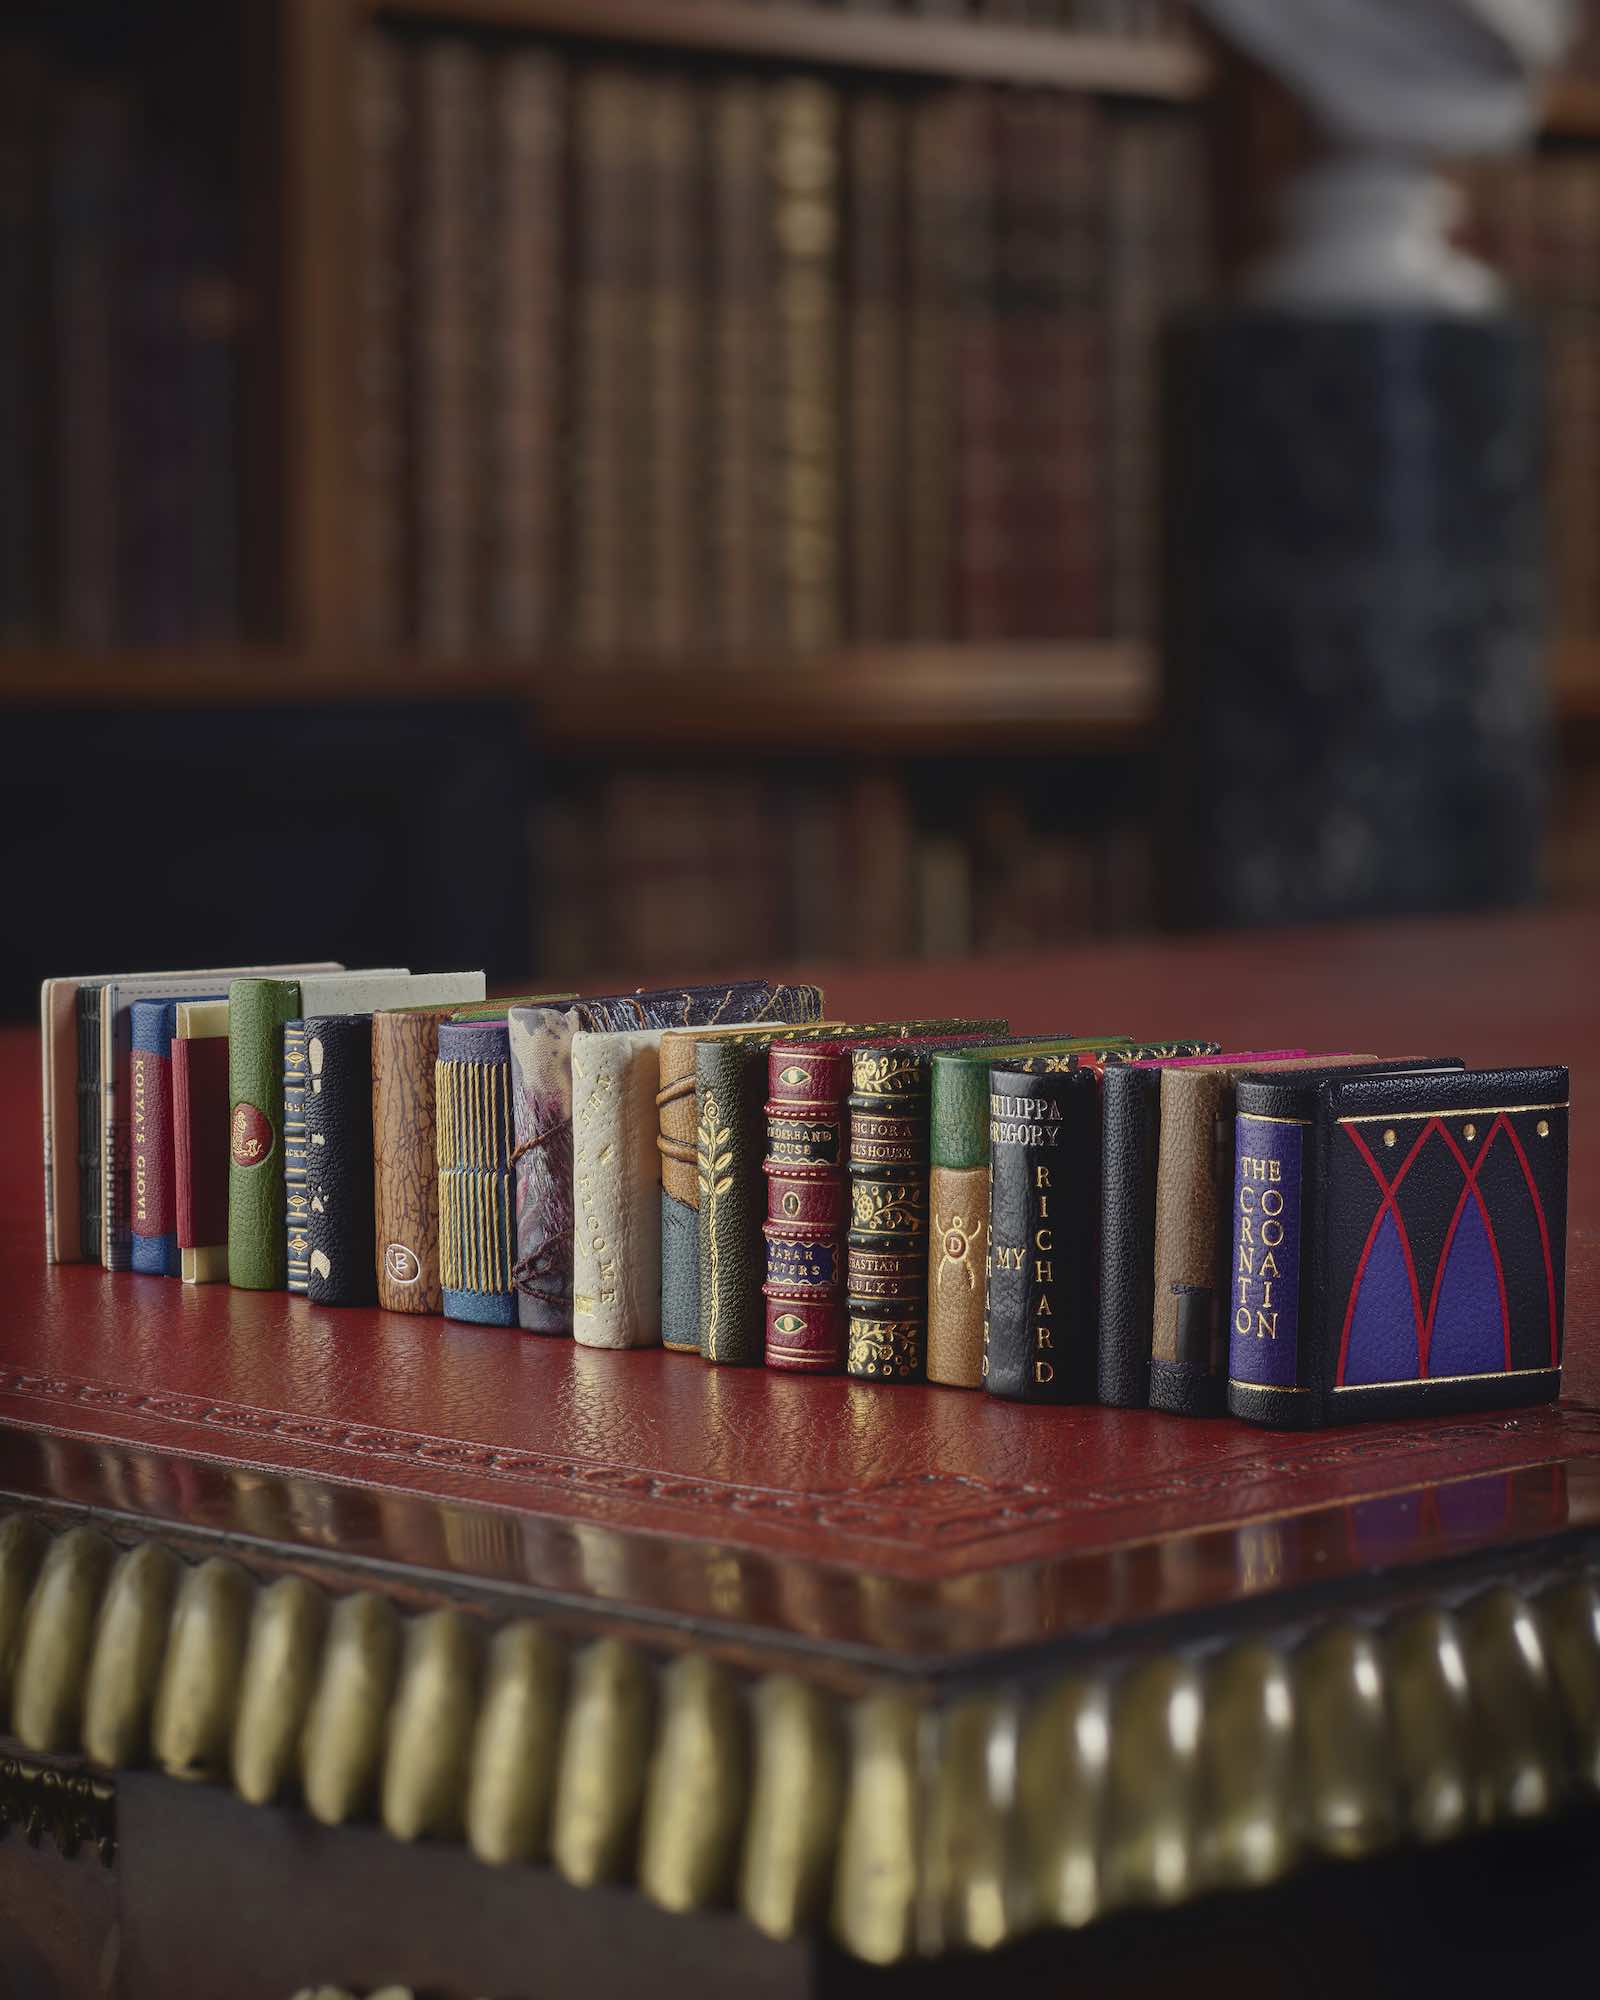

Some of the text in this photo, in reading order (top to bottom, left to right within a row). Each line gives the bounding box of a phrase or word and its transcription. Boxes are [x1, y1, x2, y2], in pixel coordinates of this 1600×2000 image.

[989, 1094, 1062, 1120] HILIPPA
[135, 1060, 146, 1219] KOLYA'S GLOVE
[989, 1121, 1059, 1146] REGORY
[773, 1142, 811, 1155] HOUSE
[1240, 1156, 1281, 1182] THE
[769, 1247, 813, 1261] SARAH
[849, 1258, 900, 1271] BASTIAN
[847, 1279, 899, 1294] AULKS
[996, 1165, 1054, 1384] MY RICHARD
